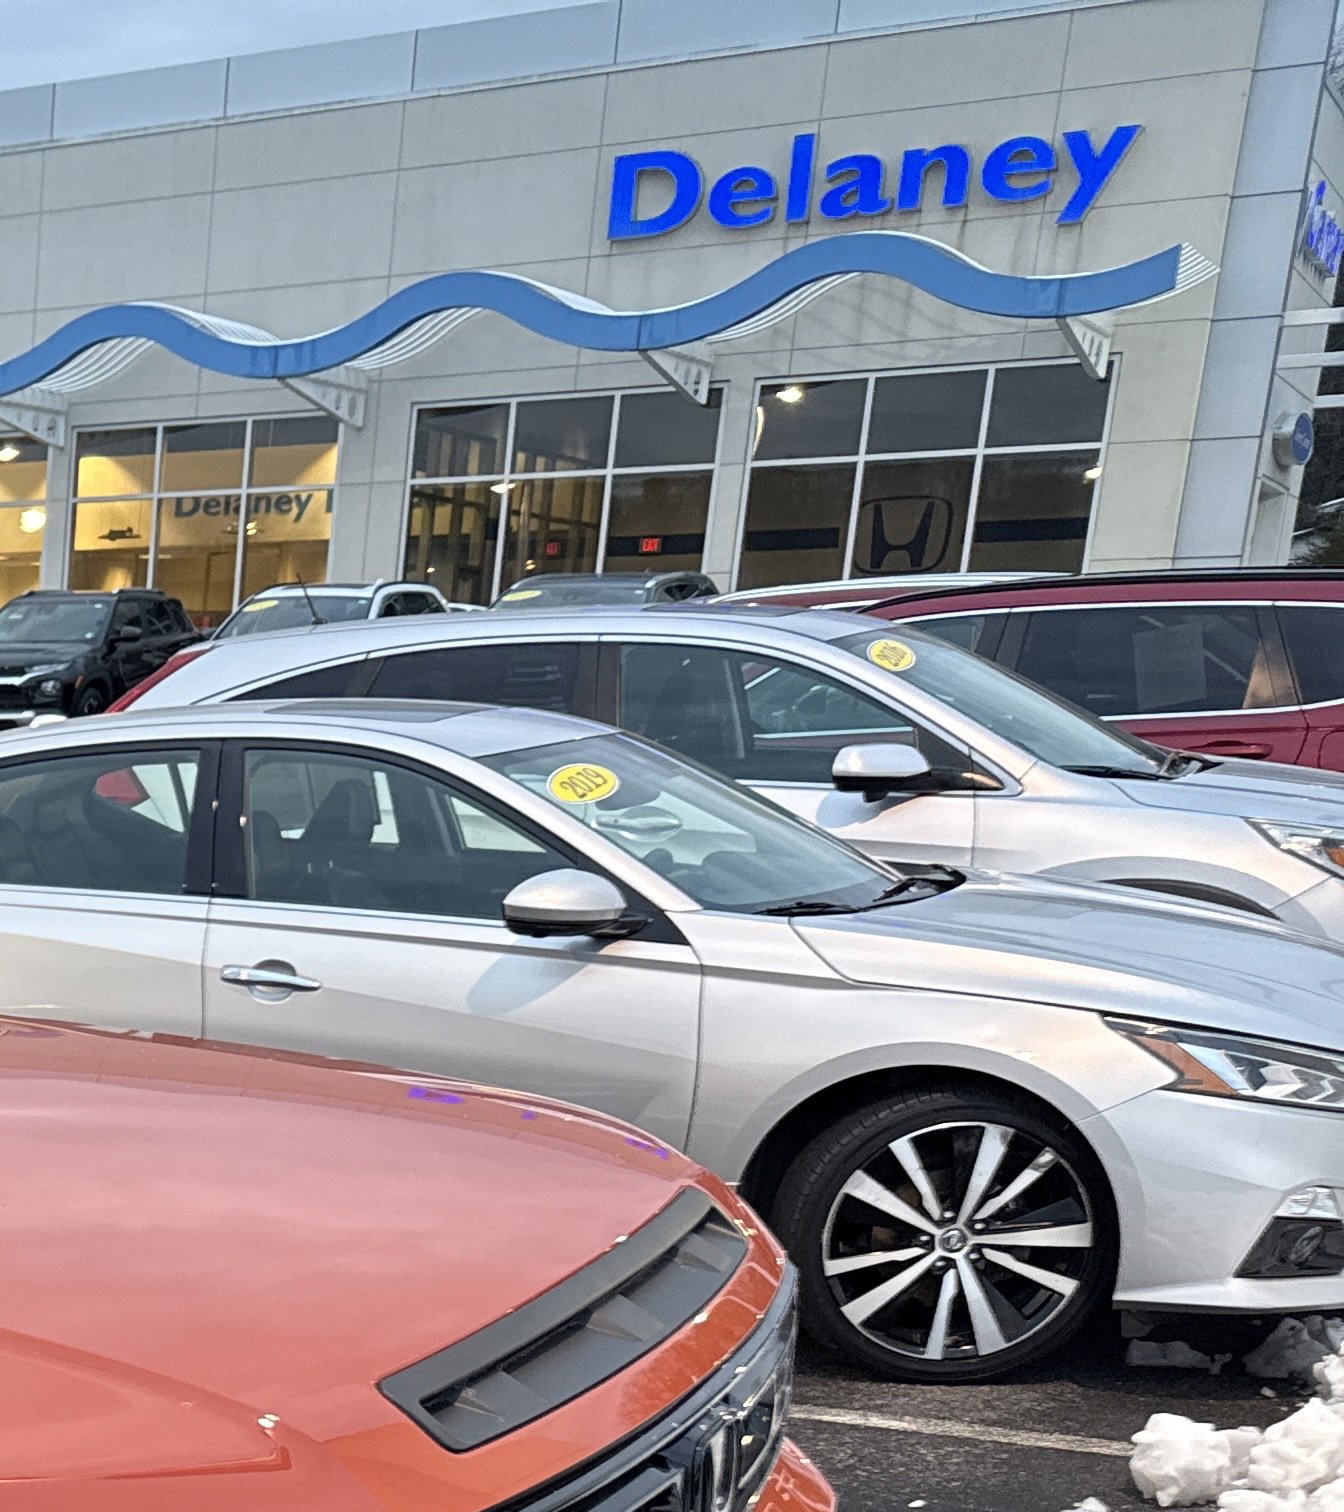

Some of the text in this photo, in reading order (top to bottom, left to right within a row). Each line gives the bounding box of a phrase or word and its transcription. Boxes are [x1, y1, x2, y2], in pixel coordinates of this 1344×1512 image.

[607, 124, 1145, 241] Delaney
[174, 492, 314, 523] Delaney
[559, 767, 608, 799] 2019
